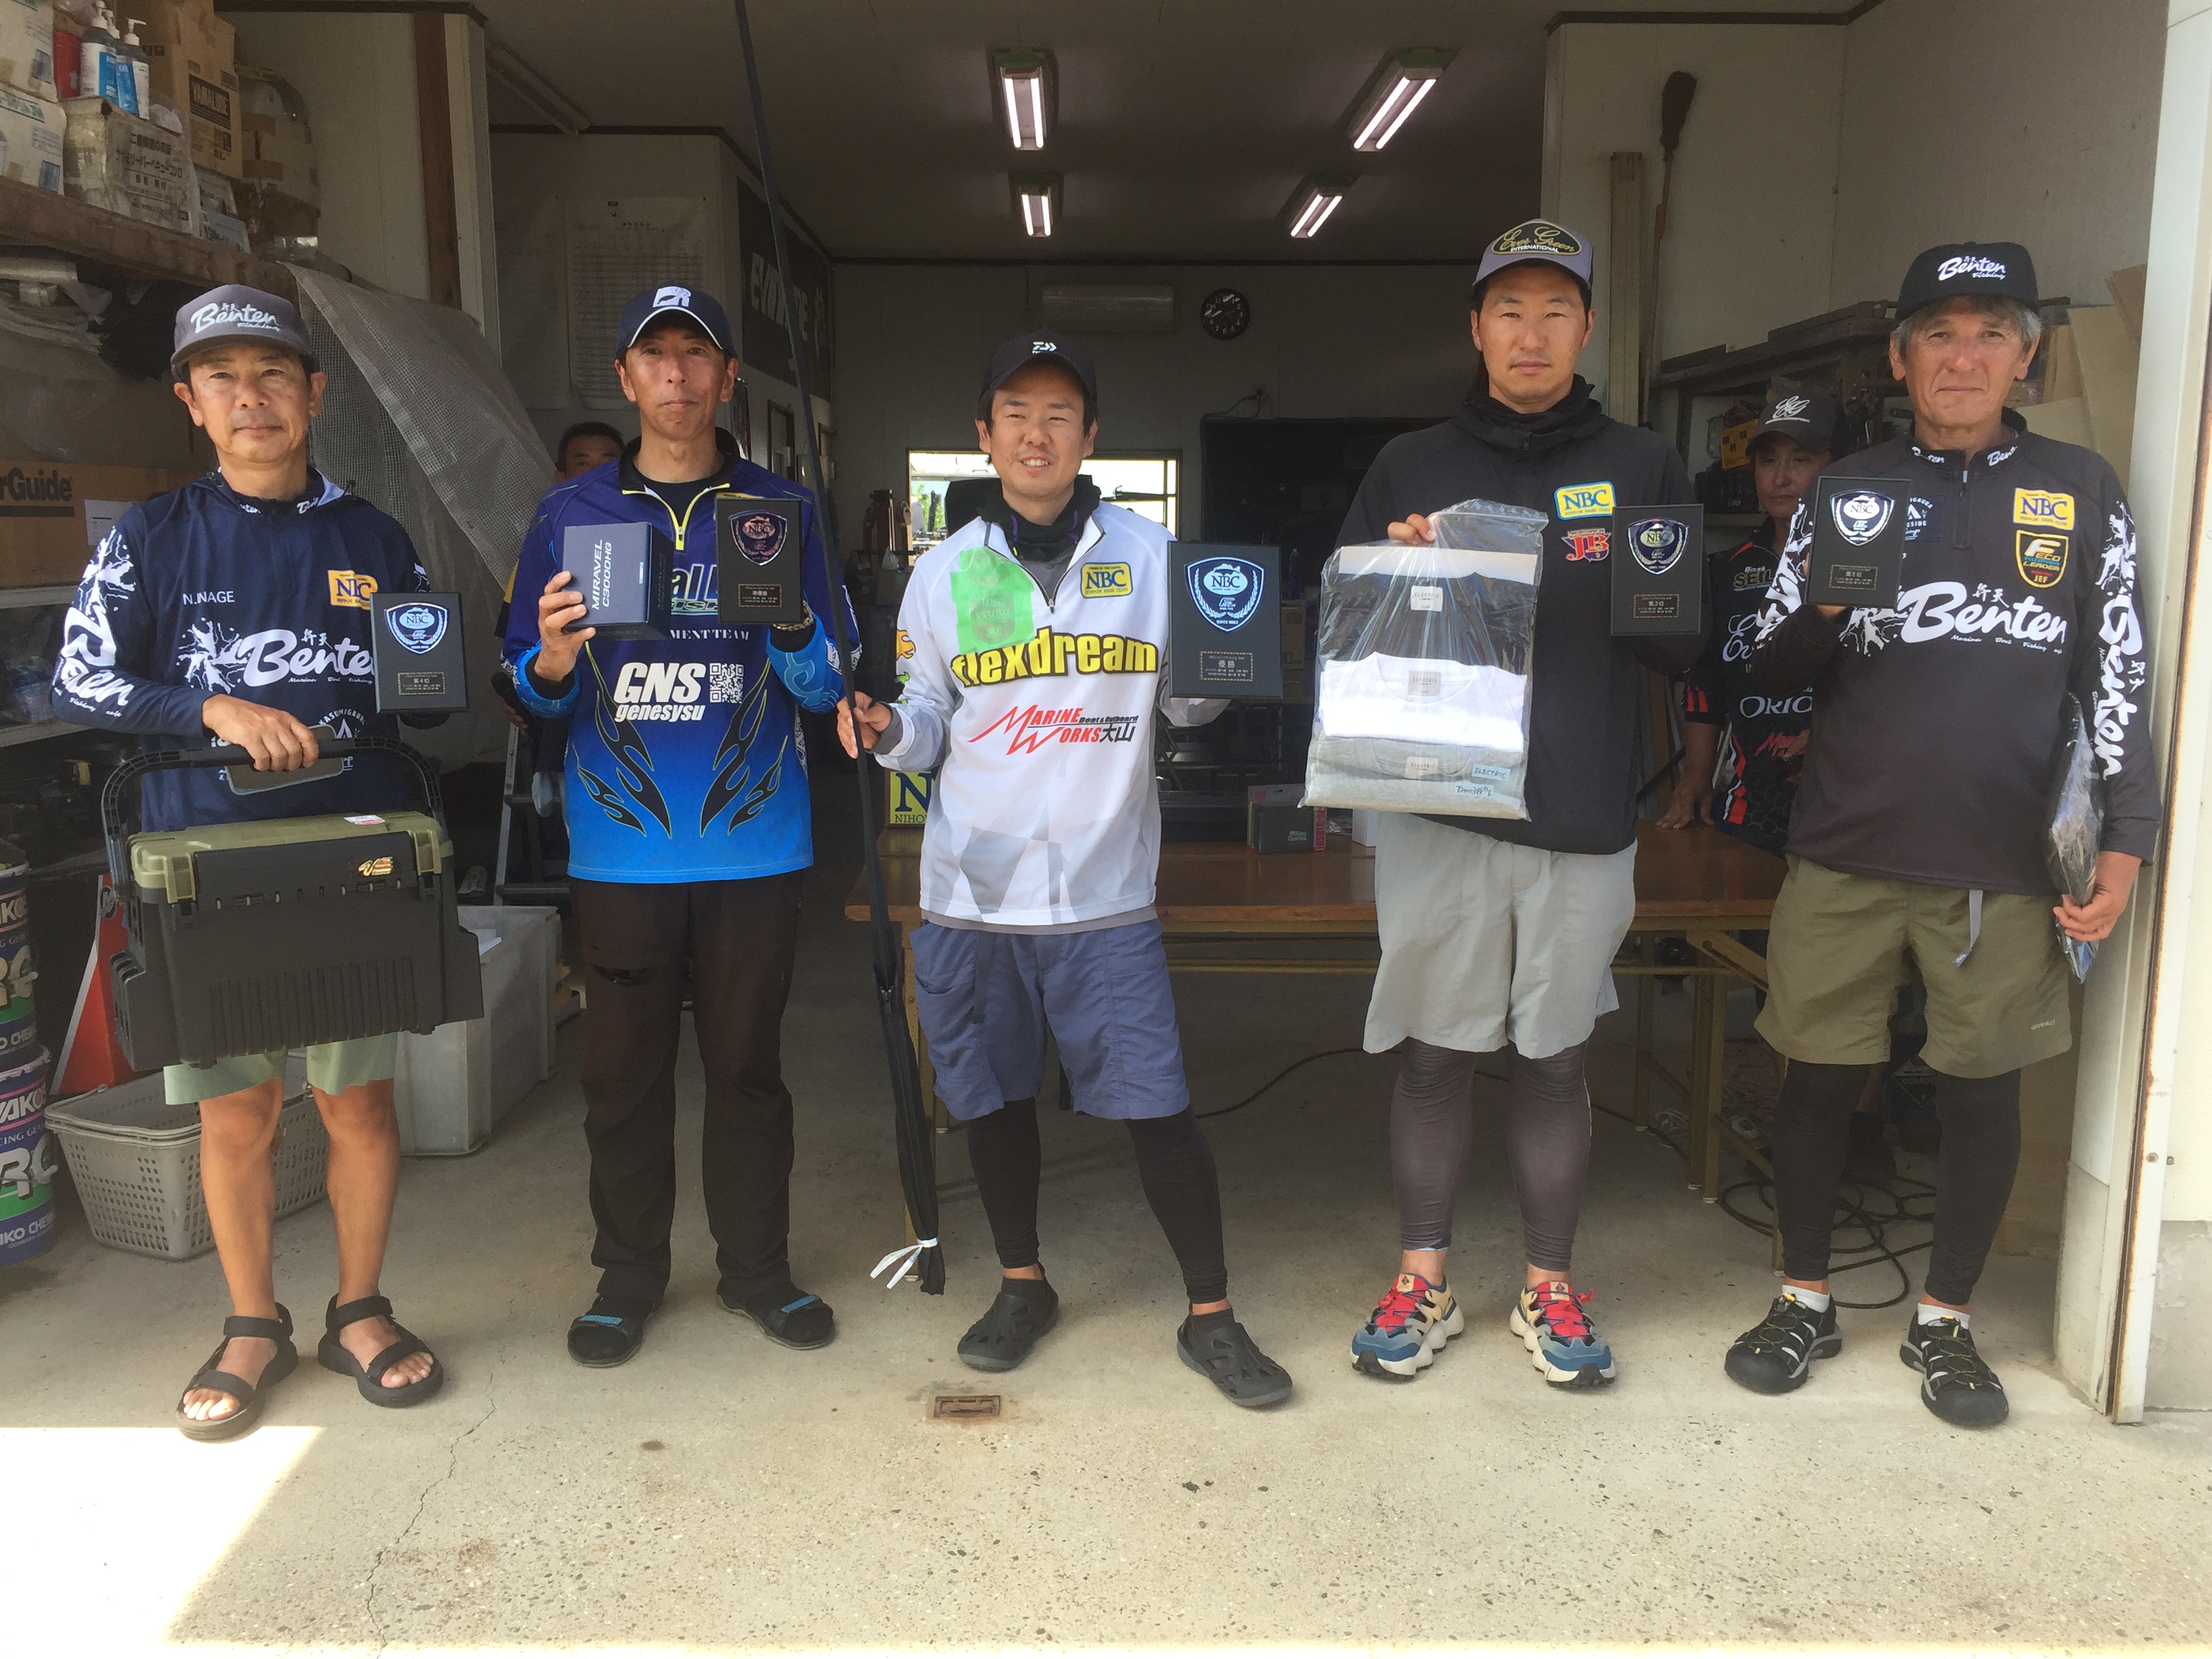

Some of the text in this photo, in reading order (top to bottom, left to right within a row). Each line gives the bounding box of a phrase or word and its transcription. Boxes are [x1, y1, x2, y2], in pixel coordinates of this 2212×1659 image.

[1510, 244, 1559, 253] INTERNATIONAL
[1937, 257, 2007, 281] Benten
[190, 302, 280, 333] Benten
[1563, 489, 1610, 510] NBC
[1850, 504, 1874, 514] NBC
[2018, 496, 2068, 520] NBC
[1565, 535, 1610, 561] JB
[591, 539, 602, 611] MIRAVEL
[602, 541, 612, 608] C3000HG
[2023, 561, 2060, 571] LEADER
[1086, 569, 1127, 590] NBC
[1211, 575, 1241, 588] NBC
[406, 615, 429, 624] NBC
[1898, 581, 2067, 644] Benten
[238, 628, 374, 687] Bente
[951, 626, 1158, 687] flexdream
[613, 661, 706, 704] GNS
[614, 703, 706, 722] genesysu
[968, 704, 1084, 743] MARINE
[1005, 726, 1103, 756] WORKS
[1099, 722, 1136, 743] 大山
[1474, 767, 1507, 779] ELECTRIC
